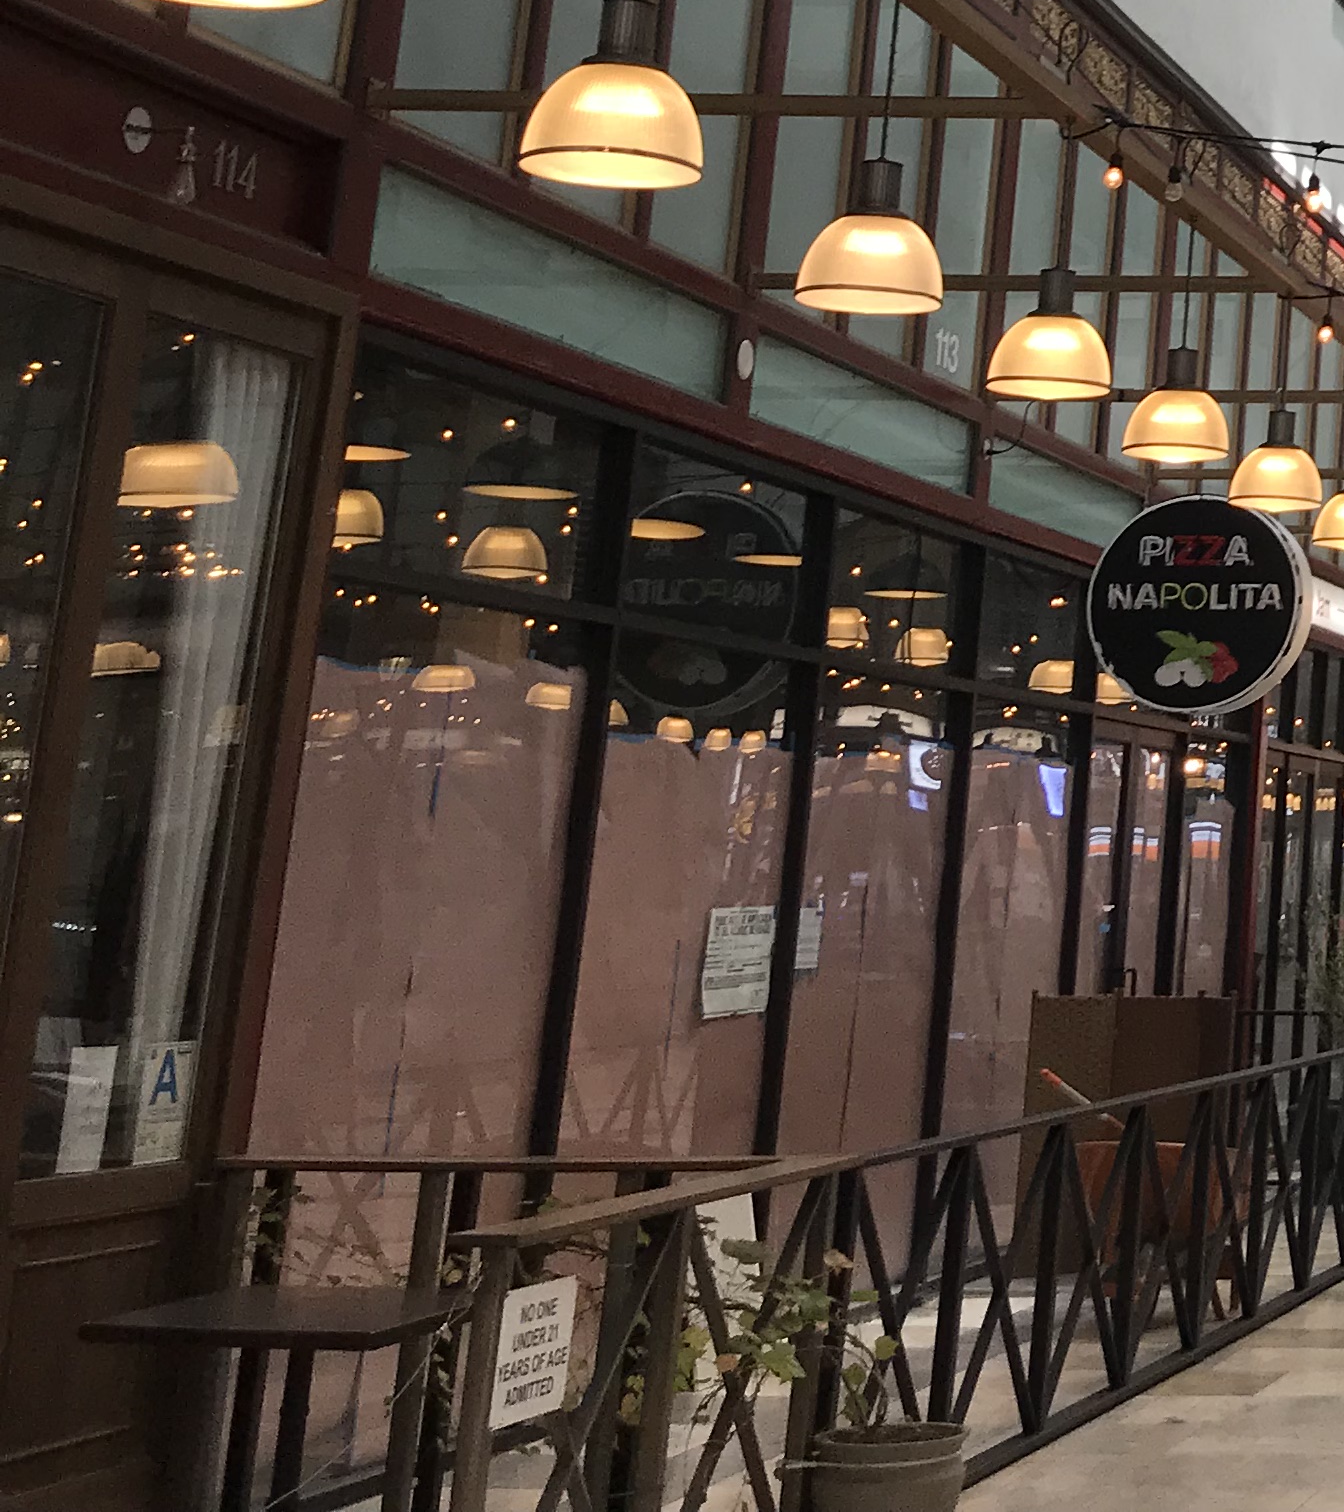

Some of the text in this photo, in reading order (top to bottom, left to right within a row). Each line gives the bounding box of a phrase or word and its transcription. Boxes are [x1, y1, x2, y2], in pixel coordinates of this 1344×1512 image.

[213, 139, 258, 199] 114
[935, 327, 960, 374] 113
[1138, 535, 1254, 566] PIZZA
[1107, 582, 1284, 610] NAPOLITA
[148, 1048, 178, 1106] A
[520, 1297, 559, 1324] NO ONE
[512, 1323, 560, 1353] UNDER 21
[498, 1345, 568, 1383] YEARS OF AGE
[504, 1376, 554, 1406] ADMITTED
